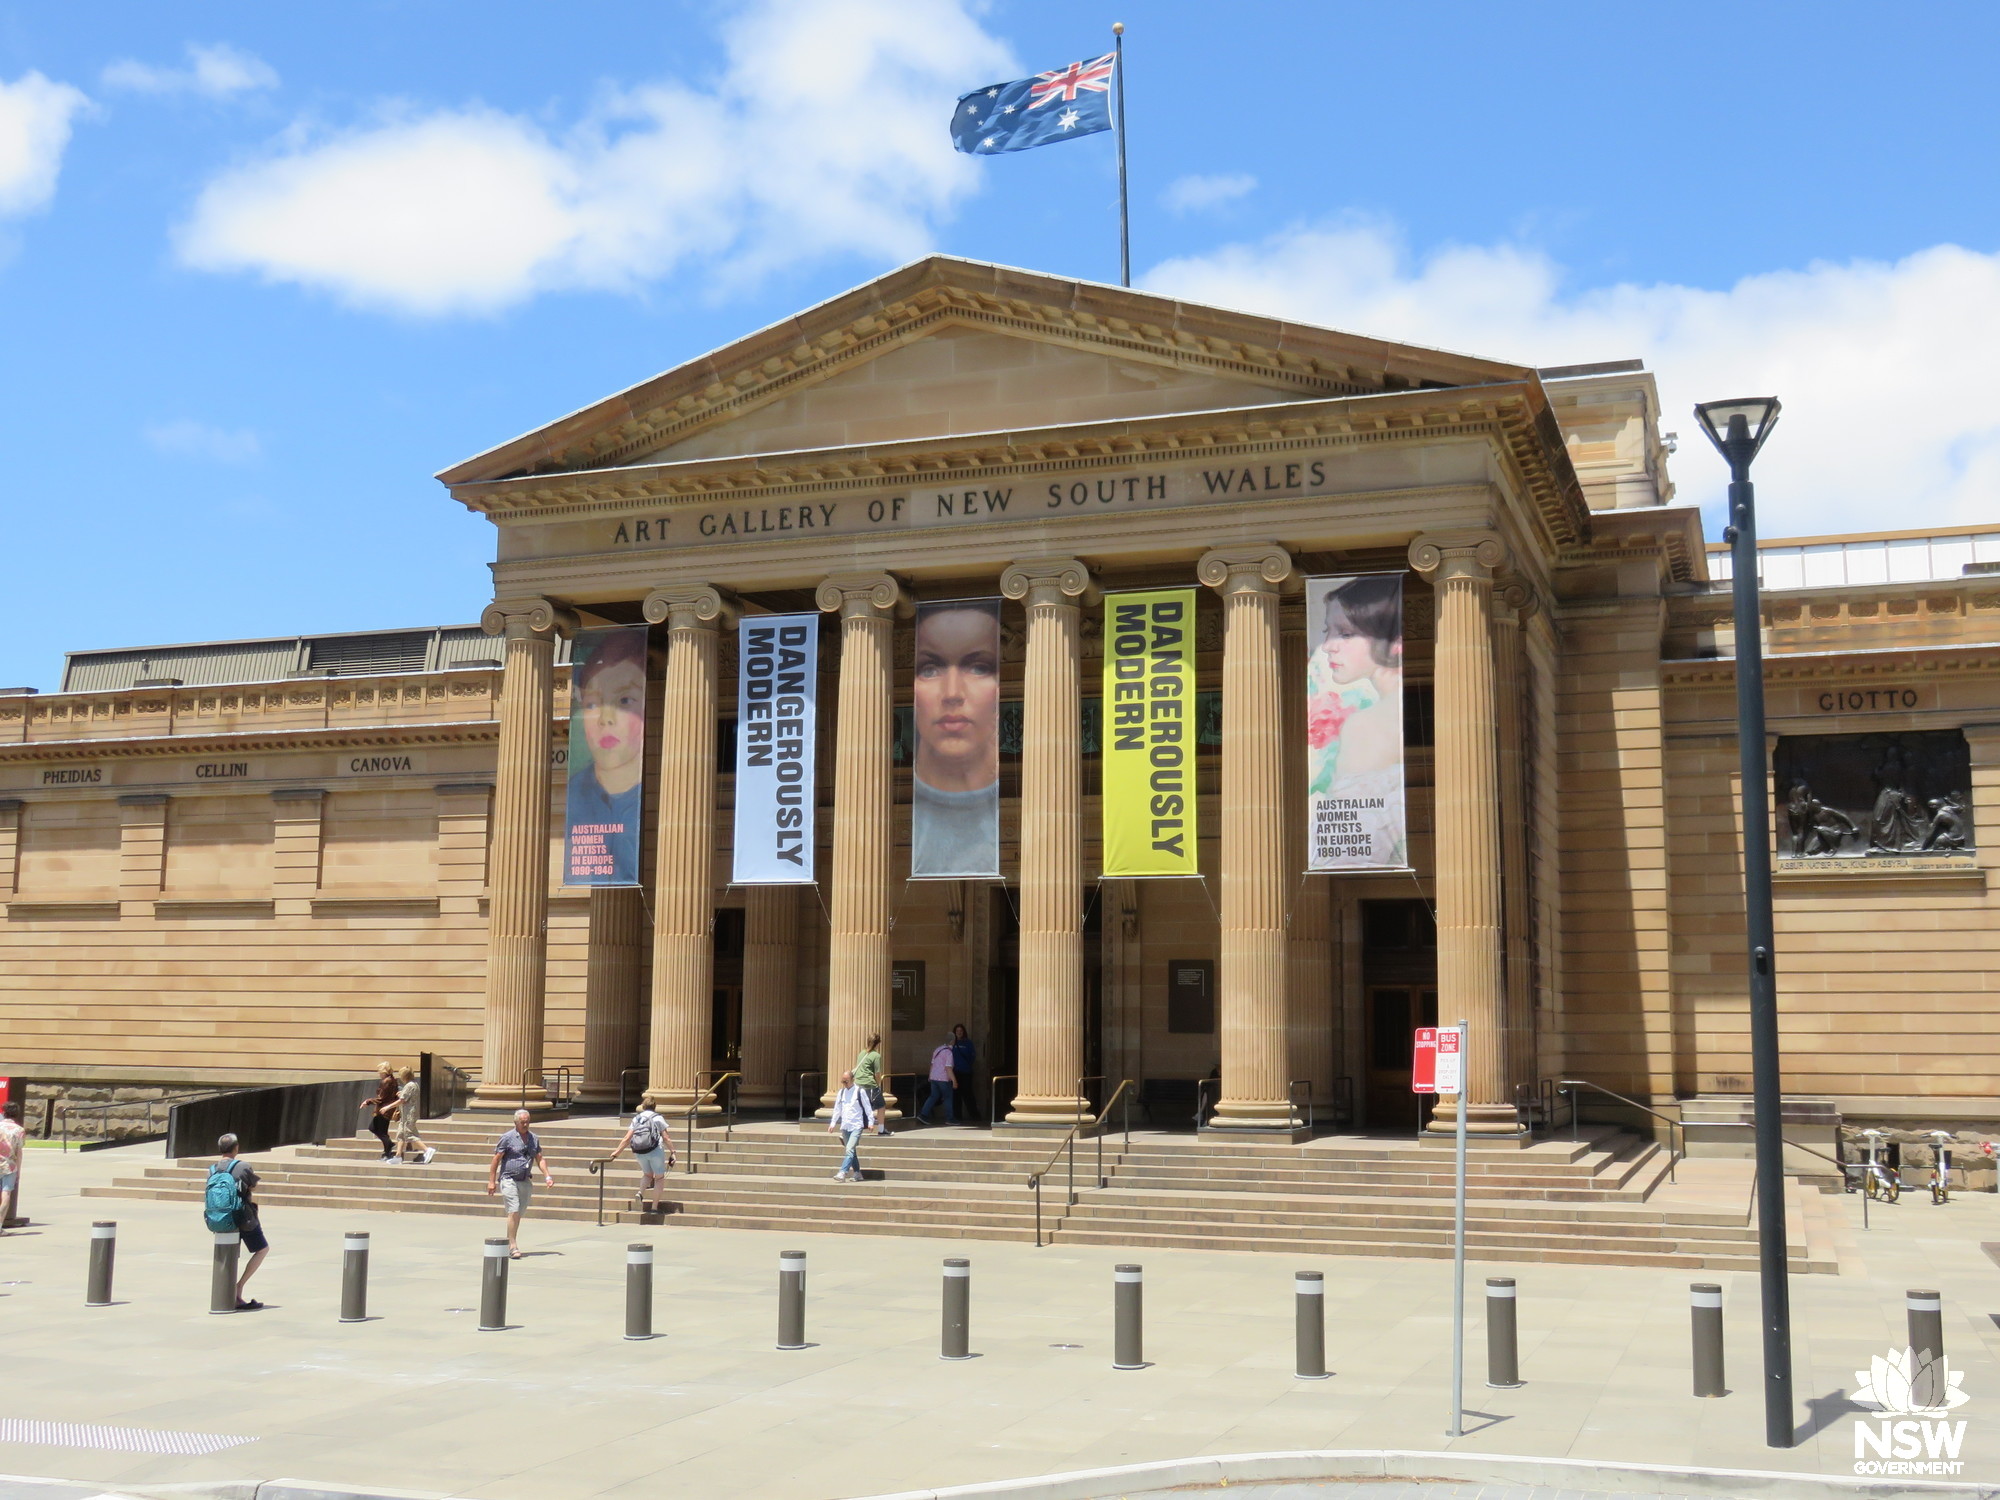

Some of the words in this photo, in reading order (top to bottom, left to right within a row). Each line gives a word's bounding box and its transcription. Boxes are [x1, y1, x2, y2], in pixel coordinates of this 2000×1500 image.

[614, 518, 671, 544] ART
[699, 503, 837, 536] GALLERY
[868, 498, 905, 523] OF
[936, 488, 1014, 518] NEW
[1047, 475, 1167, 508] SOUTH
[1203, 462, 1326, 494] WALES
[1114, 603, 1147, 751] MODERN
[746, 627, 776, 767] MODERN
[1819, 689, 1918, 712] GIOTTO
[1150, 602, 1184, 858] DANGEROUSLY
[775, 626, 807, 866] DANGEROUSLY
[351, 756, 412, 772] CANOVA
[196, 763, 248, 778] CELLINI
[43, 769, 102, 785] PHEIDIAS
[1316, 798, 1385, 811] AUSTRALIAN
[1316, 811, 1358, 822] WOMEN
[572, 823, 624, 834] AUSTRALIAN
[1316, 823, 1362, 834] ARTISTS
[571, 835, 604, 845] WOMEN
[1317, 836, 1328, 846] IN
[1330, 834, 1372, 845] EUROPE
[571, 845, 607, 855] ARTISTS
[1316, 846, 1372, 858] 1890-1940
[571, 856, 580, 865] IN
[582, 855, 614, 865] EUROPE
[571, 866, 614, 876] 1890-1940
[1422, 1032, 1431, 1040] NO
[1440, 1034, 1457, 1042] BUS
[1441, 1043, 1456, 1052] ZONE
